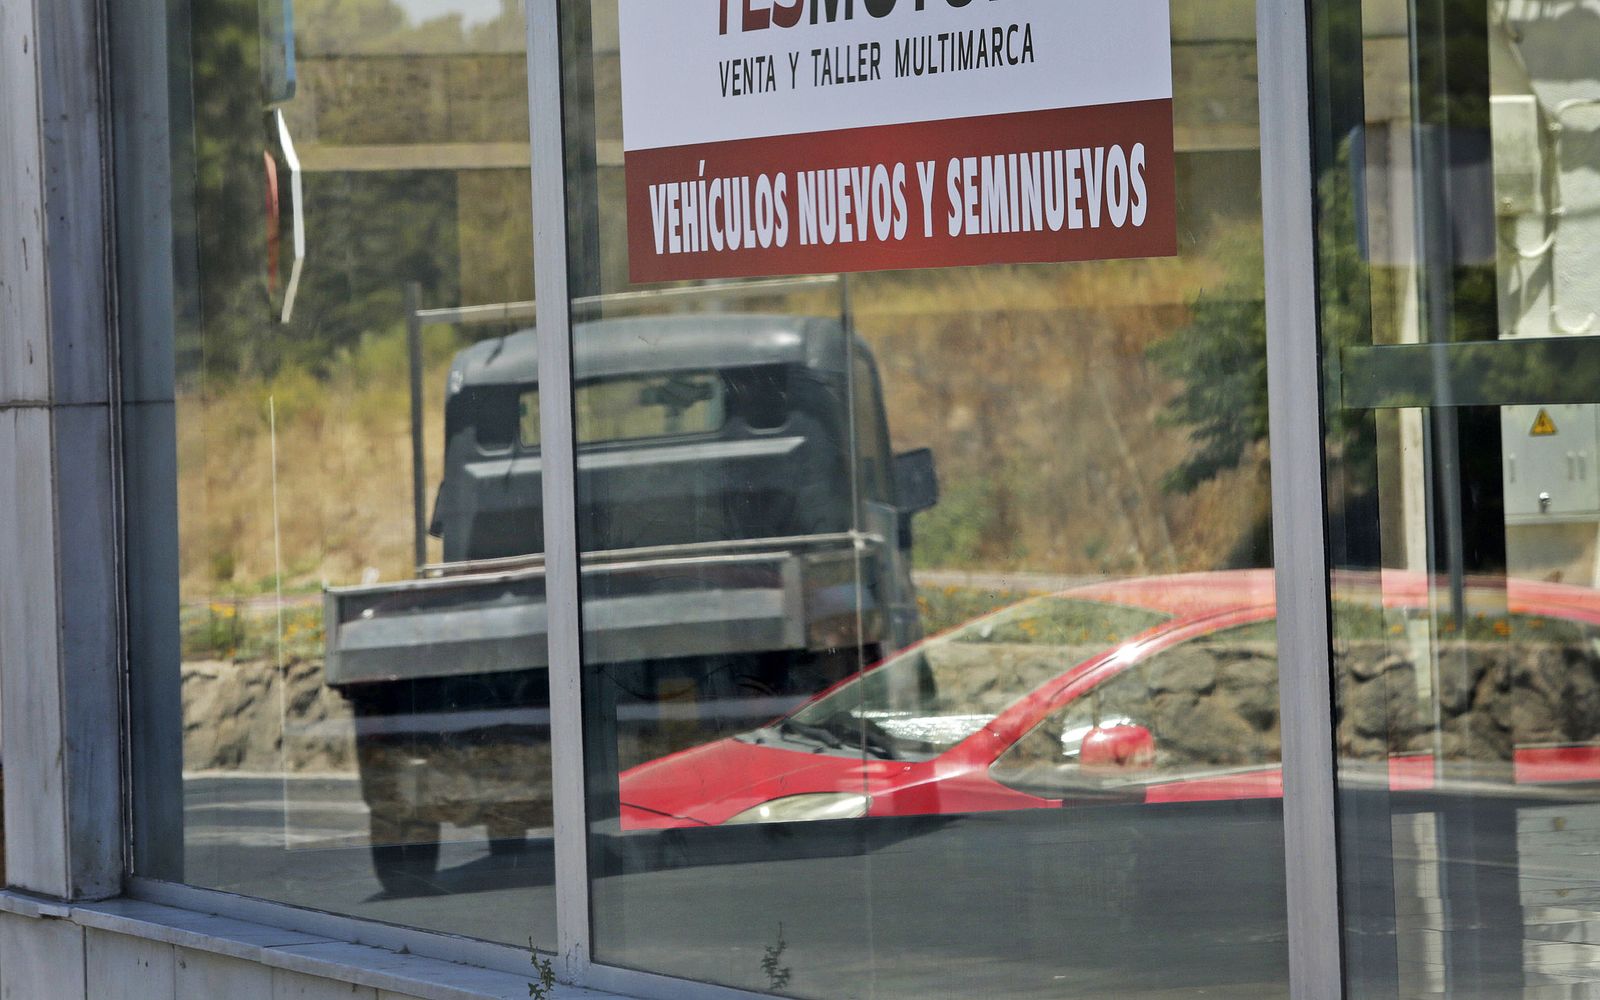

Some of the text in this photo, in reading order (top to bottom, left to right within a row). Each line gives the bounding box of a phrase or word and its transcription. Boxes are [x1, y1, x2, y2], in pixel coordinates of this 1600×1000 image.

[718, 22, 1035, 98] VENTA Y TALLER MULTIMARCA
[648, 142, 1149, 255] VEHÍCULOS NUEVOS Y SEMINUEVOS
